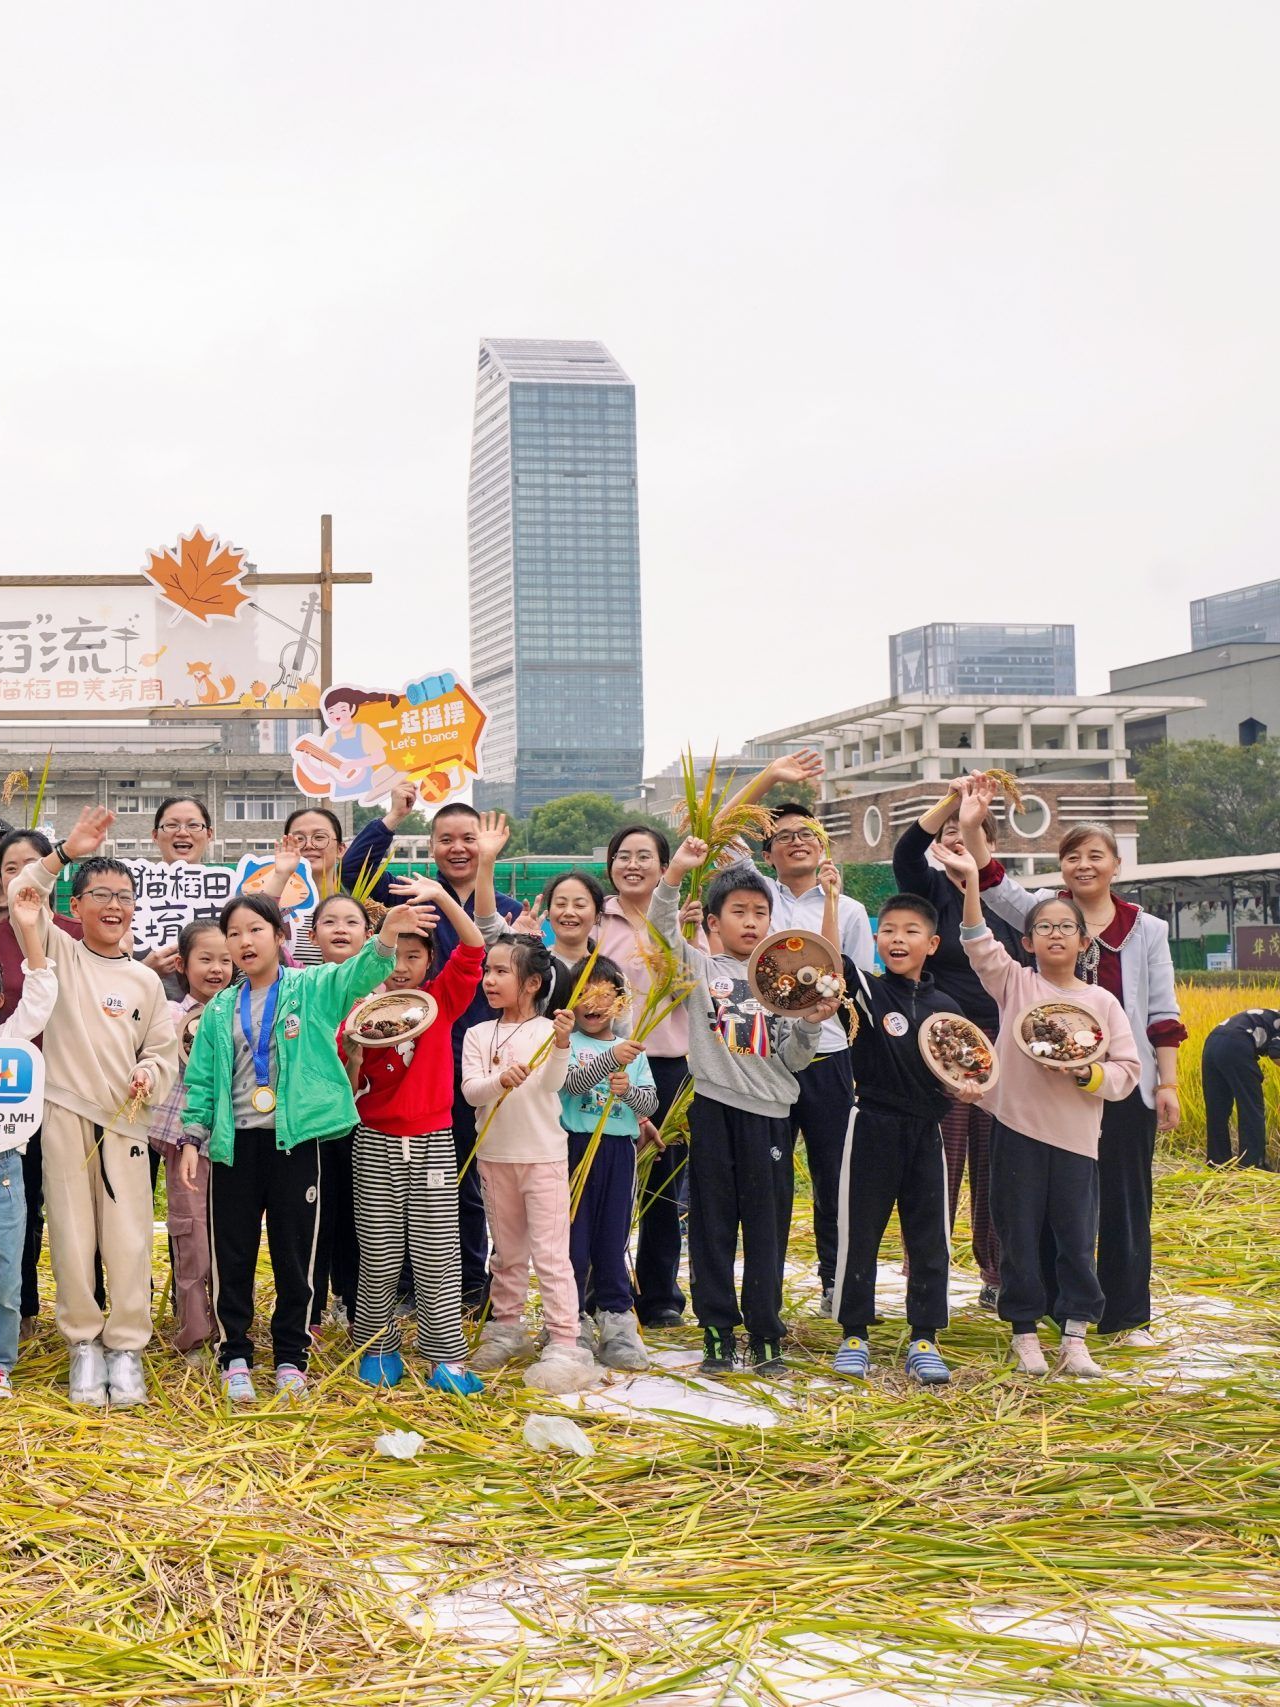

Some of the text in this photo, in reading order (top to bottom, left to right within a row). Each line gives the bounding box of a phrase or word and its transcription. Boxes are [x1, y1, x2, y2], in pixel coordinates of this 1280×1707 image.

[378, 700, 466, 735] 一起摇摆
[390, 730, 459, 751] Let's Dance
[128, 865, 231, 900] 猫稻田
[9, 1113, 35, 1123] MH
